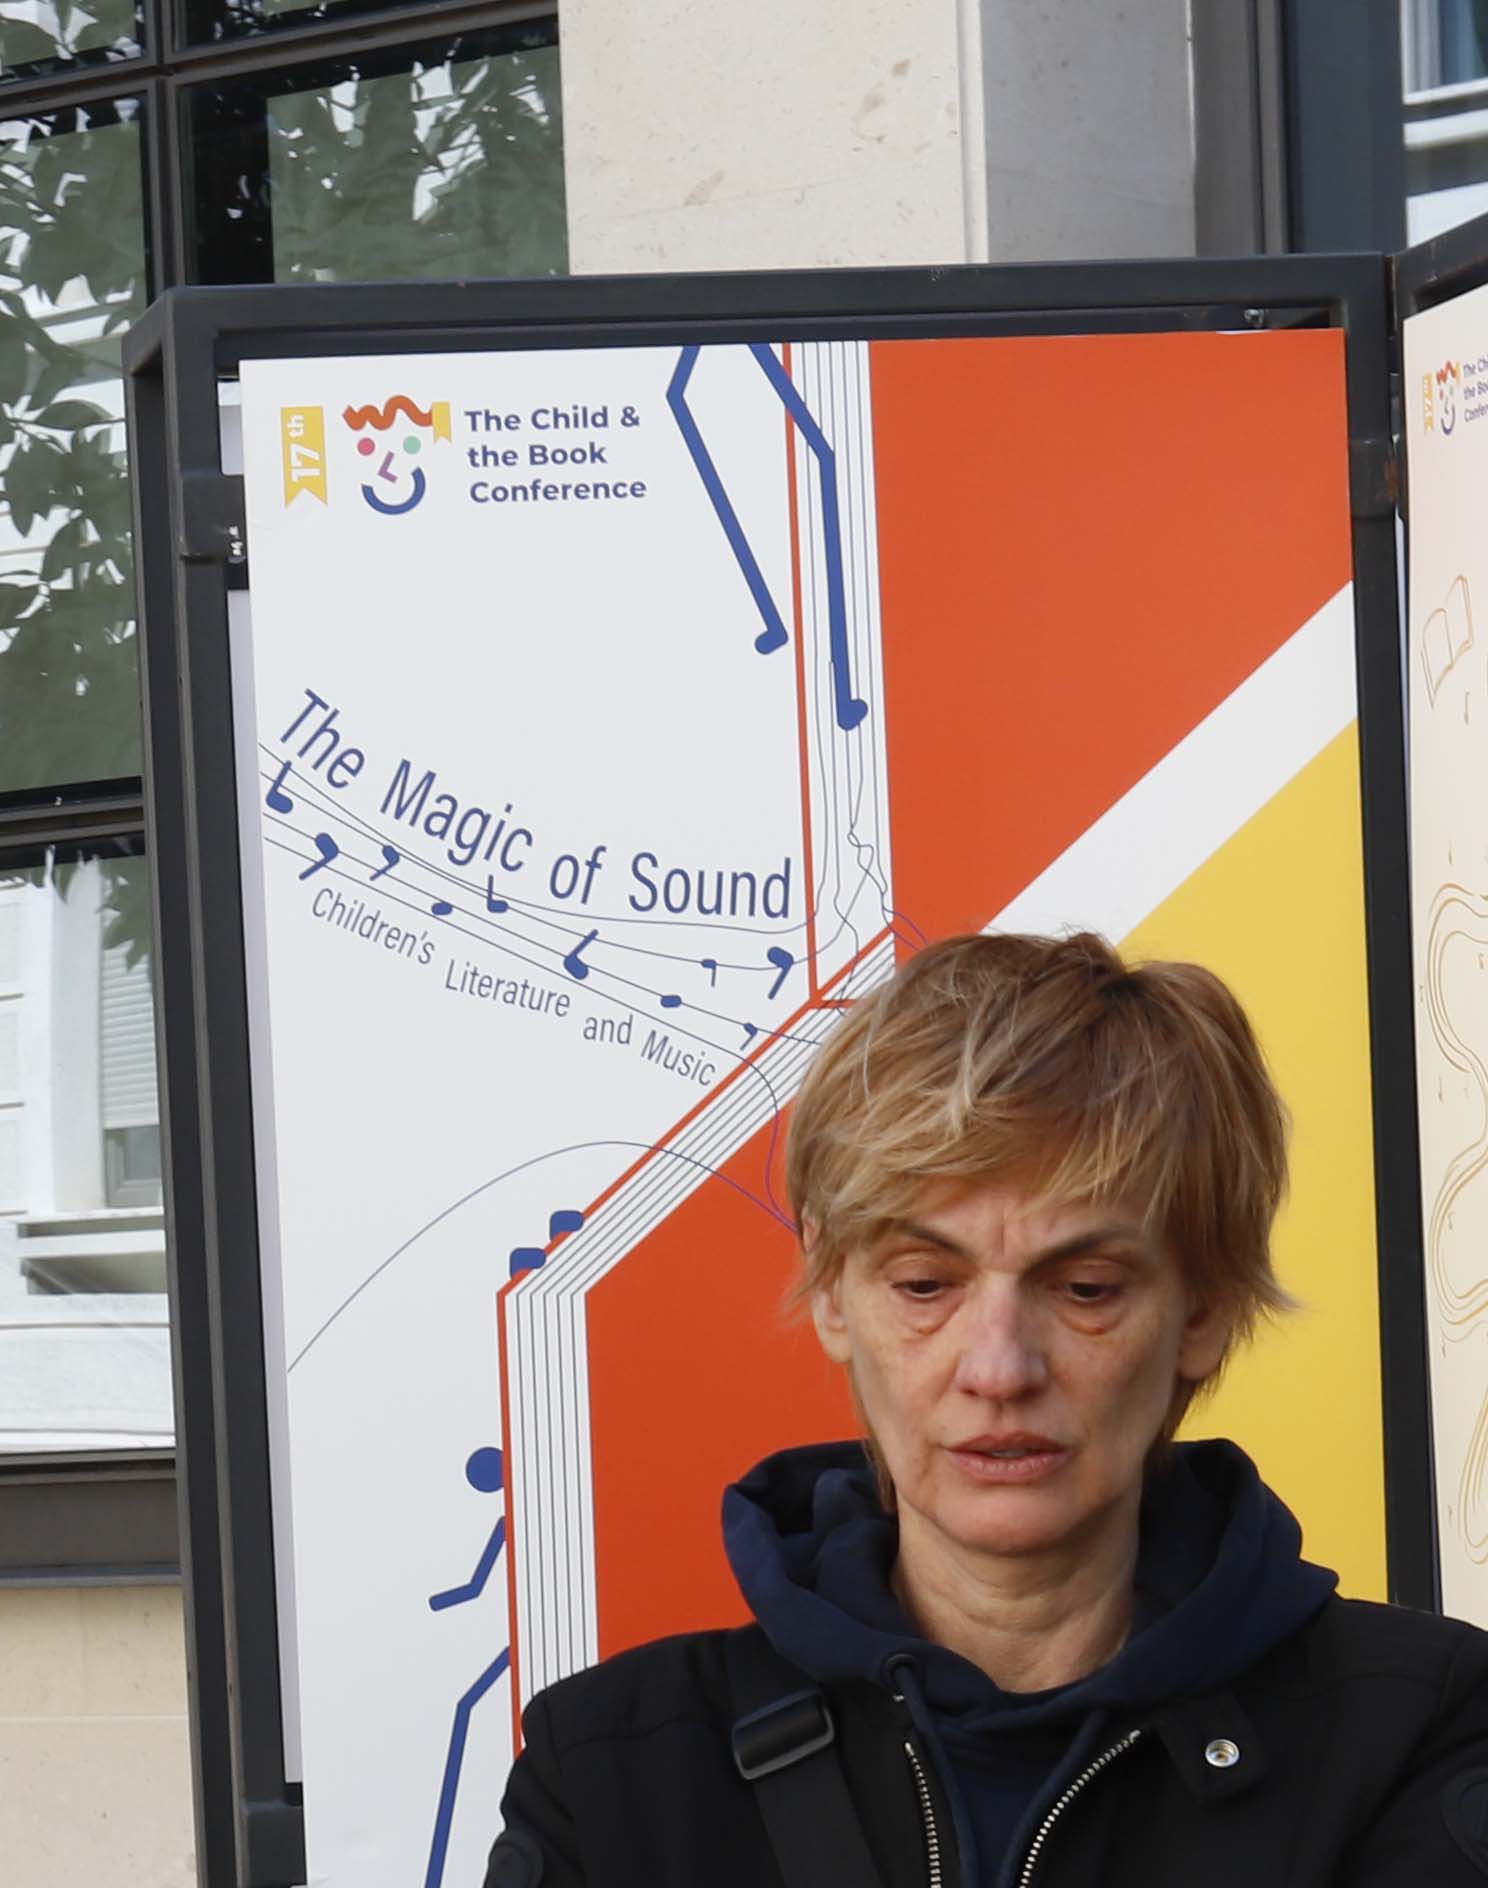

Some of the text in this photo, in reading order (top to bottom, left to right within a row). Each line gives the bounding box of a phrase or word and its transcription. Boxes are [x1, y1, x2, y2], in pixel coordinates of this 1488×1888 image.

[464, 405, 641, 432] The Child &
[284, 412, 319, 484] 17th
[468, 442, 608, 468] the Book
[470, 475, 647, 504] Conference
[277, 688, 795, 920] The Magic of Sound
[312, 887, 719, 1088] Children's Literature and Music
